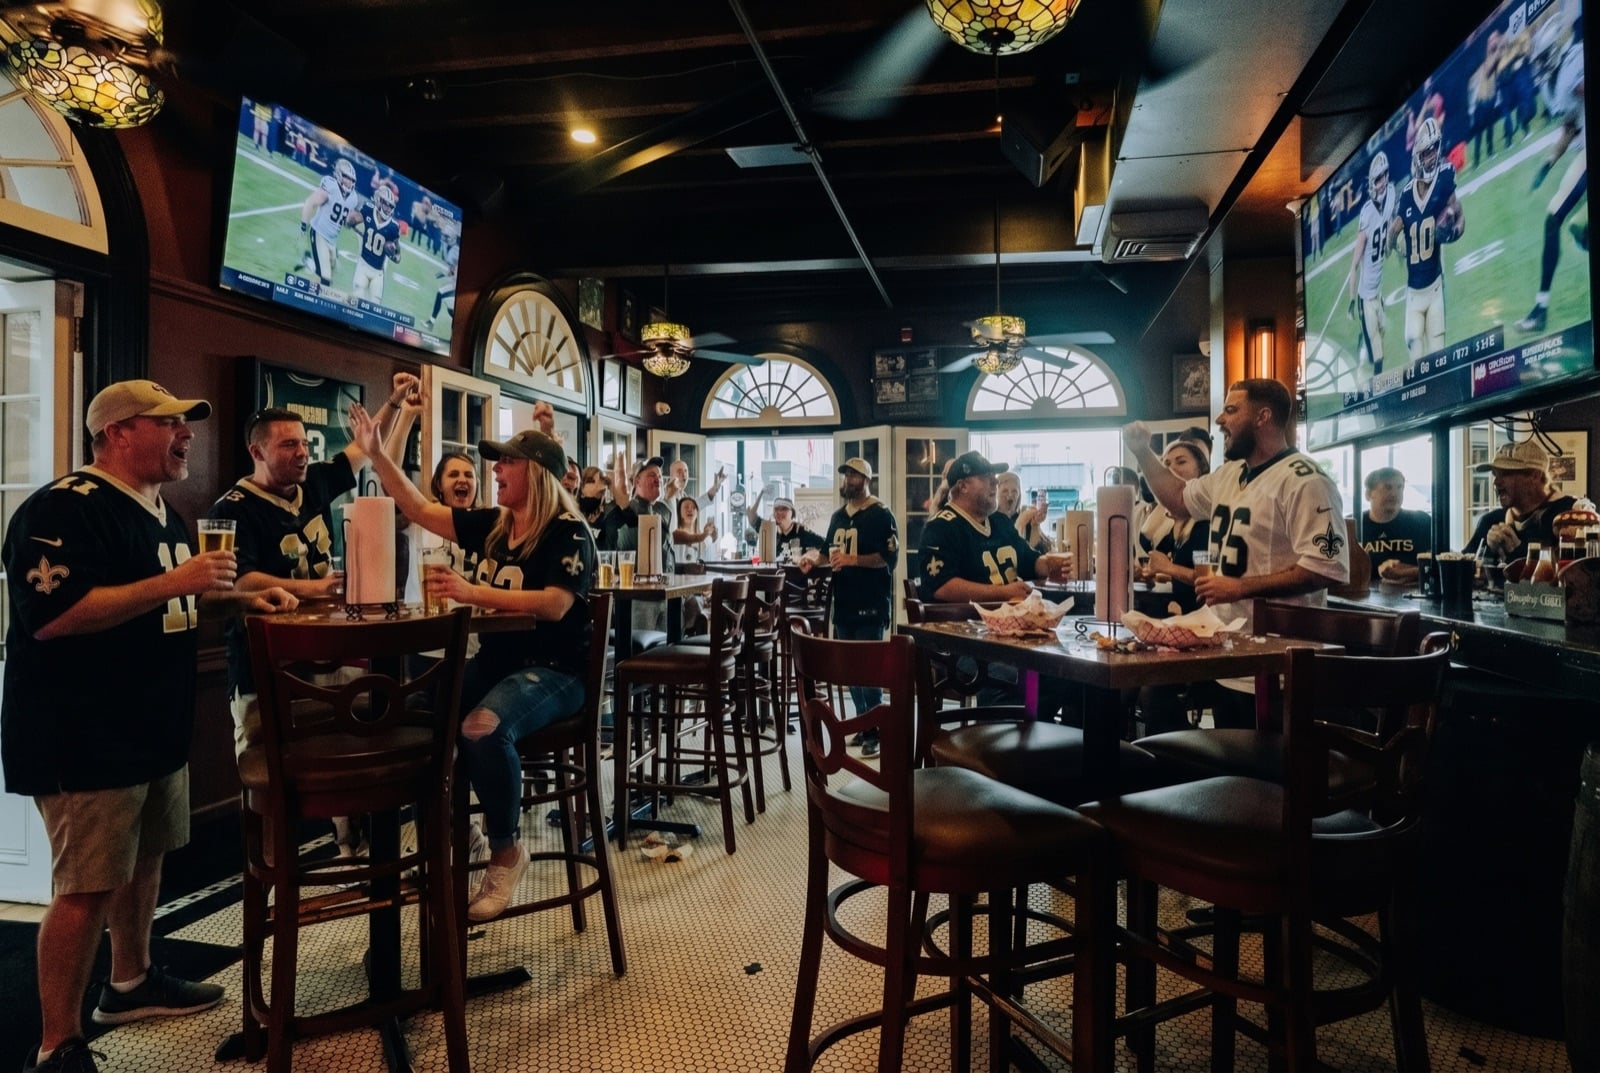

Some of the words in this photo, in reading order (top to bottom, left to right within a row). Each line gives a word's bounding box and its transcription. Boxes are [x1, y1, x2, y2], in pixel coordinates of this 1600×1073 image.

[365, 227, 386, 257] 10
[1409, 215, 1436, 265] 10
[1358, 539, 1414, 553] AINTS
